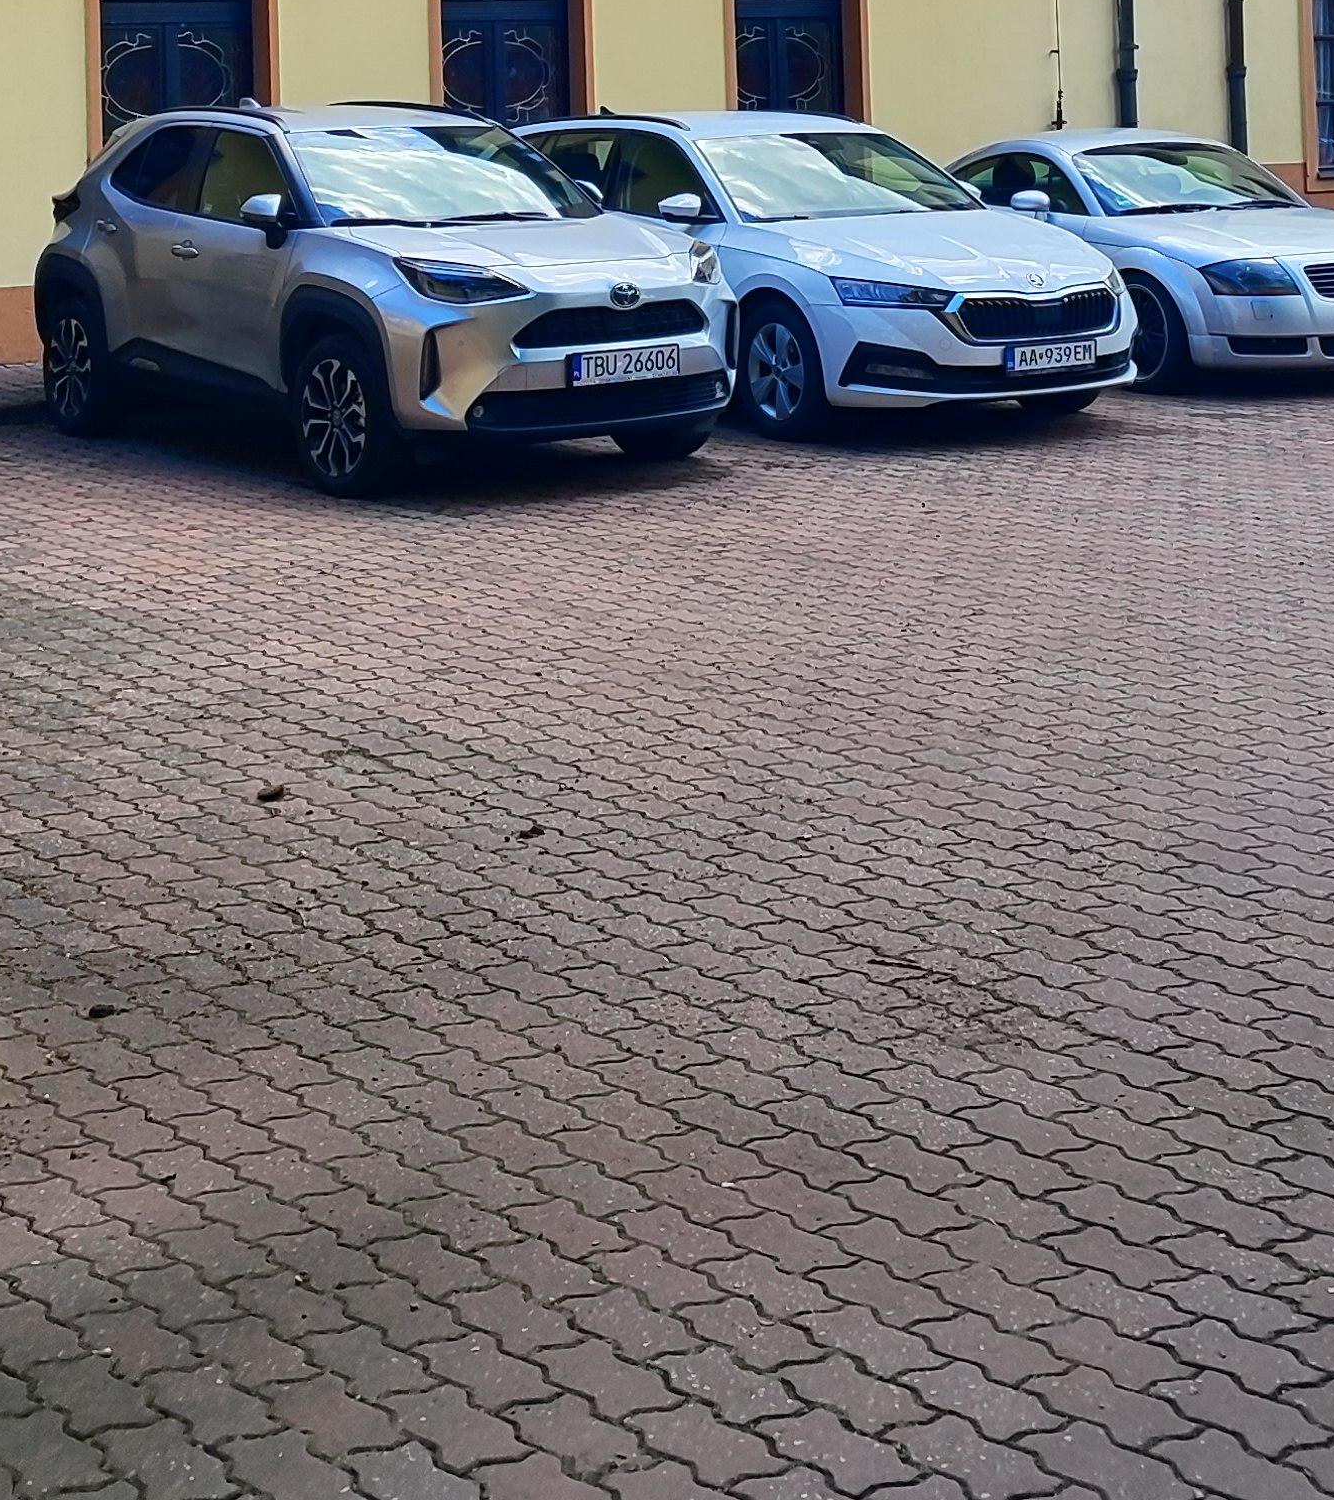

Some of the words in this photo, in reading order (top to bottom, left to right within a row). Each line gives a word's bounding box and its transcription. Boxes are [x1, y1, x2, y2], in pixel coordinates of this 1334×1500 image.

[583, 355, 618, 379] TBU
[622, 348, 676, 375] 26606
[1019, 350, 1038, 367] AA
